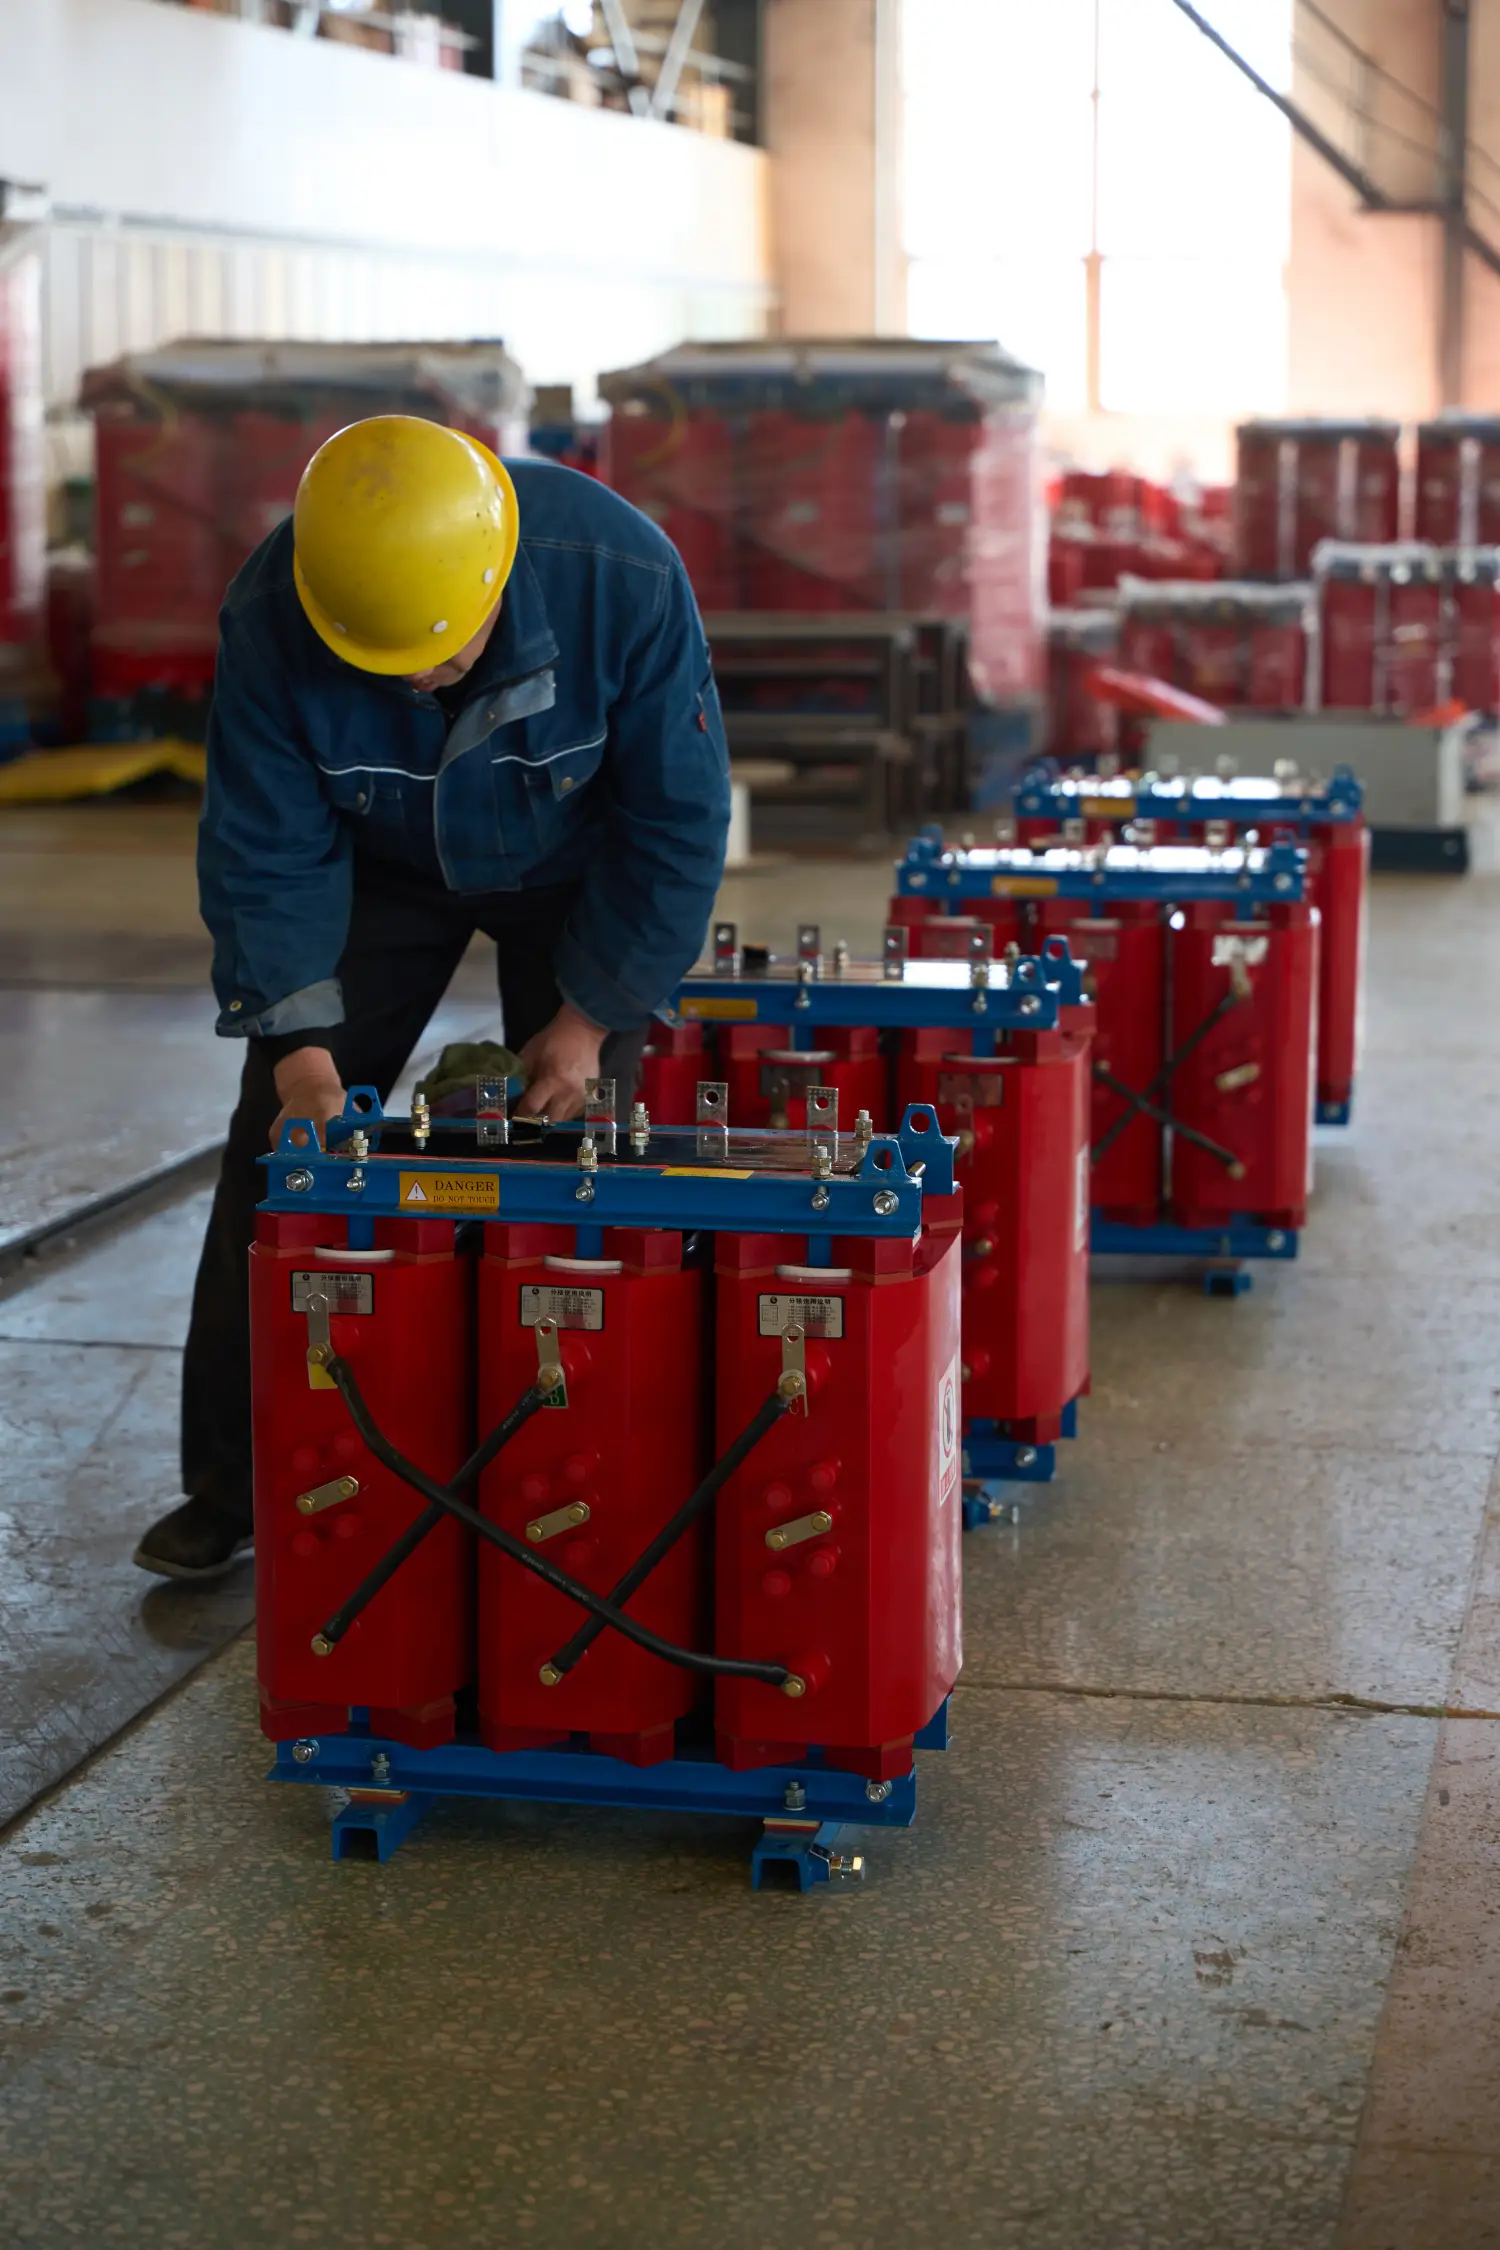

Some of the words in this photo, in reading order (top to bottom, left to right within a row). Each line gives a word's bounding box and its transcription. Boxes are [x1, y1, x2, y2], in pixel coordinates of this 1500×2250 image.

[435, 1180, 495, 1192] DANGER
[433, 1195, 445, 1203] DO
[448, 1195, 465, 1204] NOT
[468, 1196, 495, 1204] TOUCH
